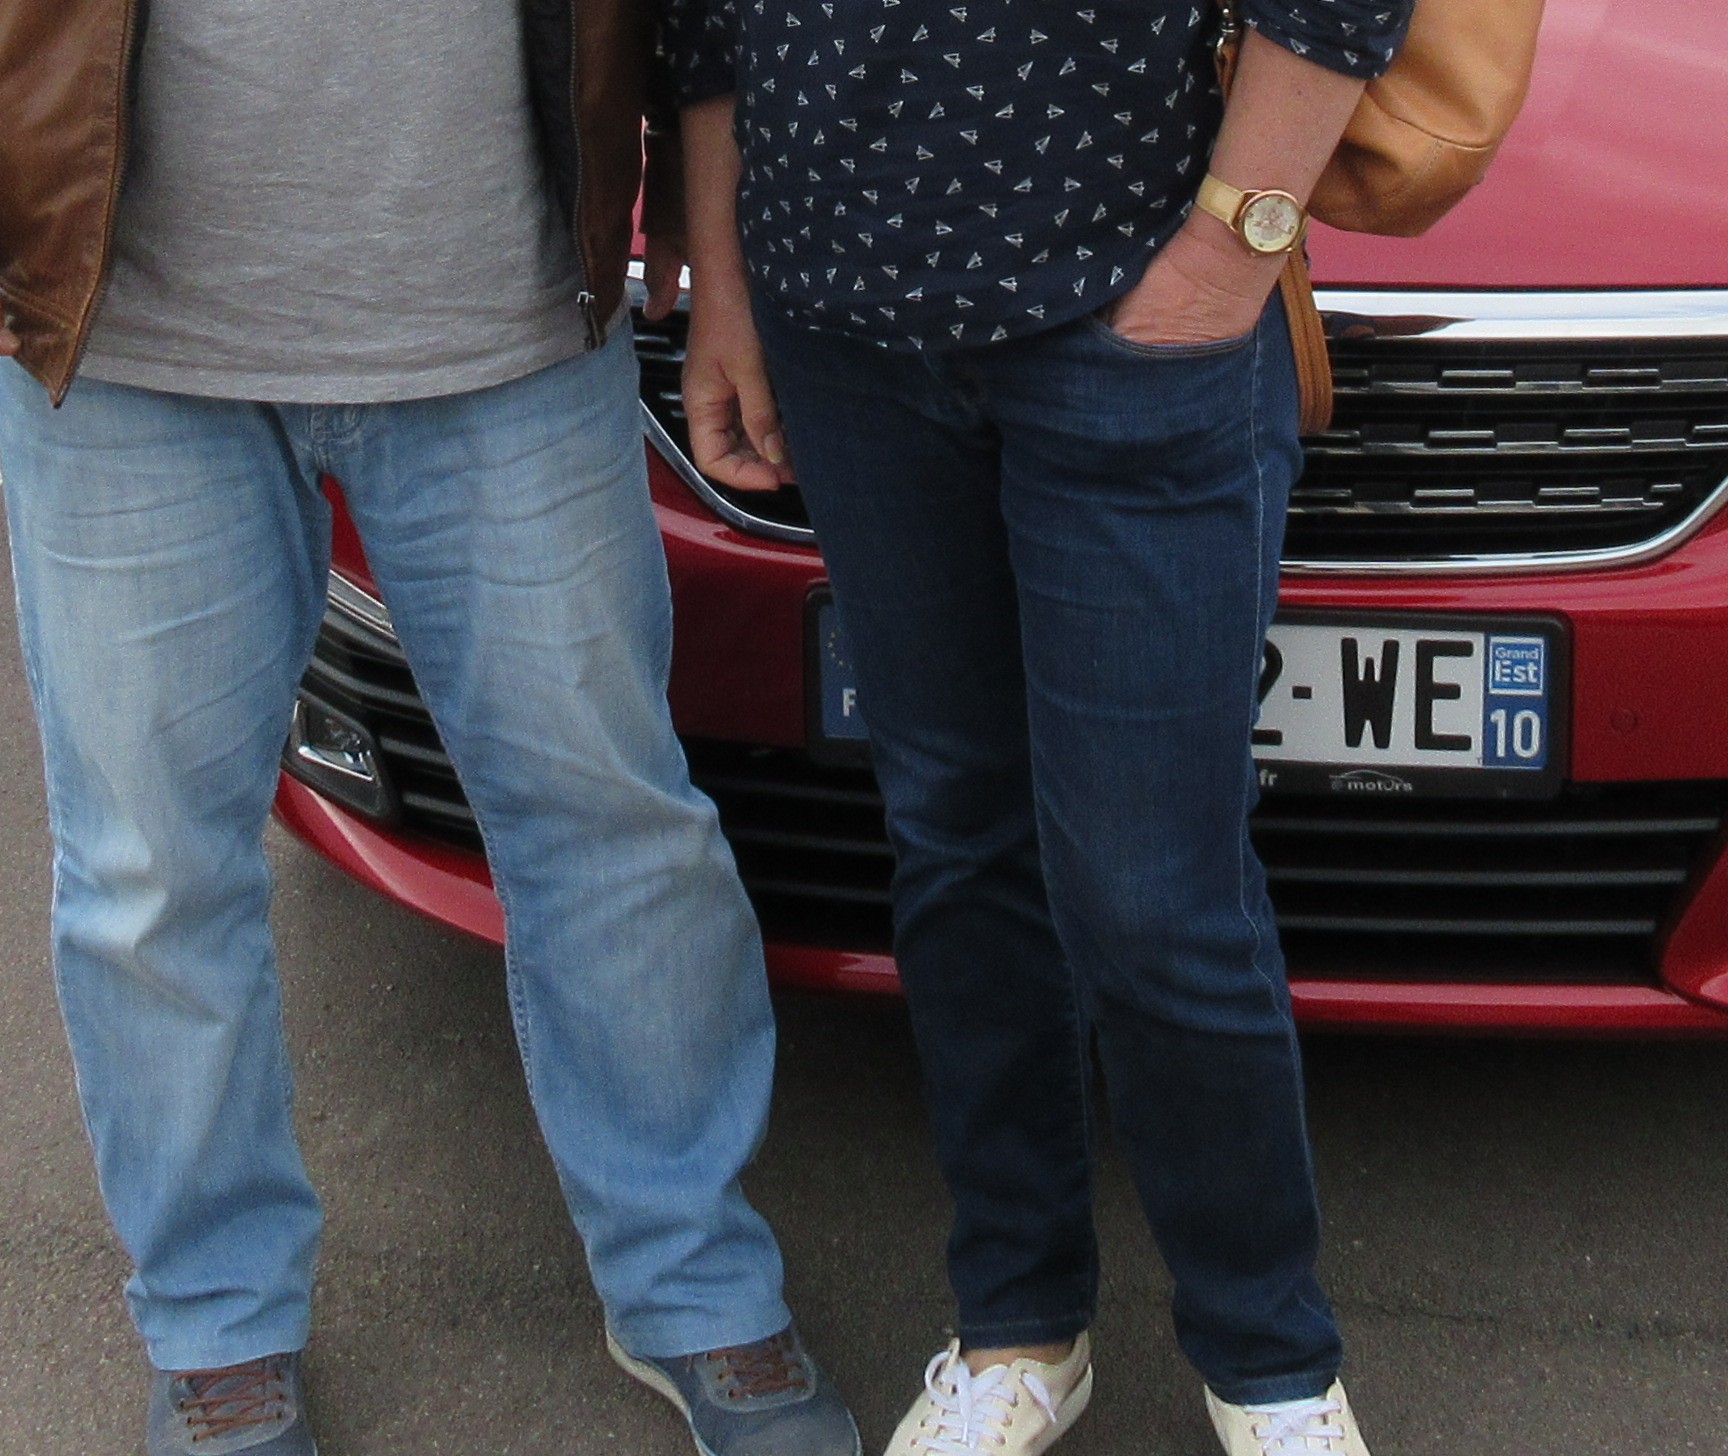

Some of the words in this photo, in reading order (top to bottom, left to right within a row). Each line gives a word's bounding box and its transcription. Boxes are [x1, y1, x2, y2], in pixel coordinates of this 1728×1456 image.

[1494, 647, 1539, 660] Grand
[1494, 660, 1538, 684] Est
[842, 688, 857, 717] F
[1490, 709, 1541, 758] 10
